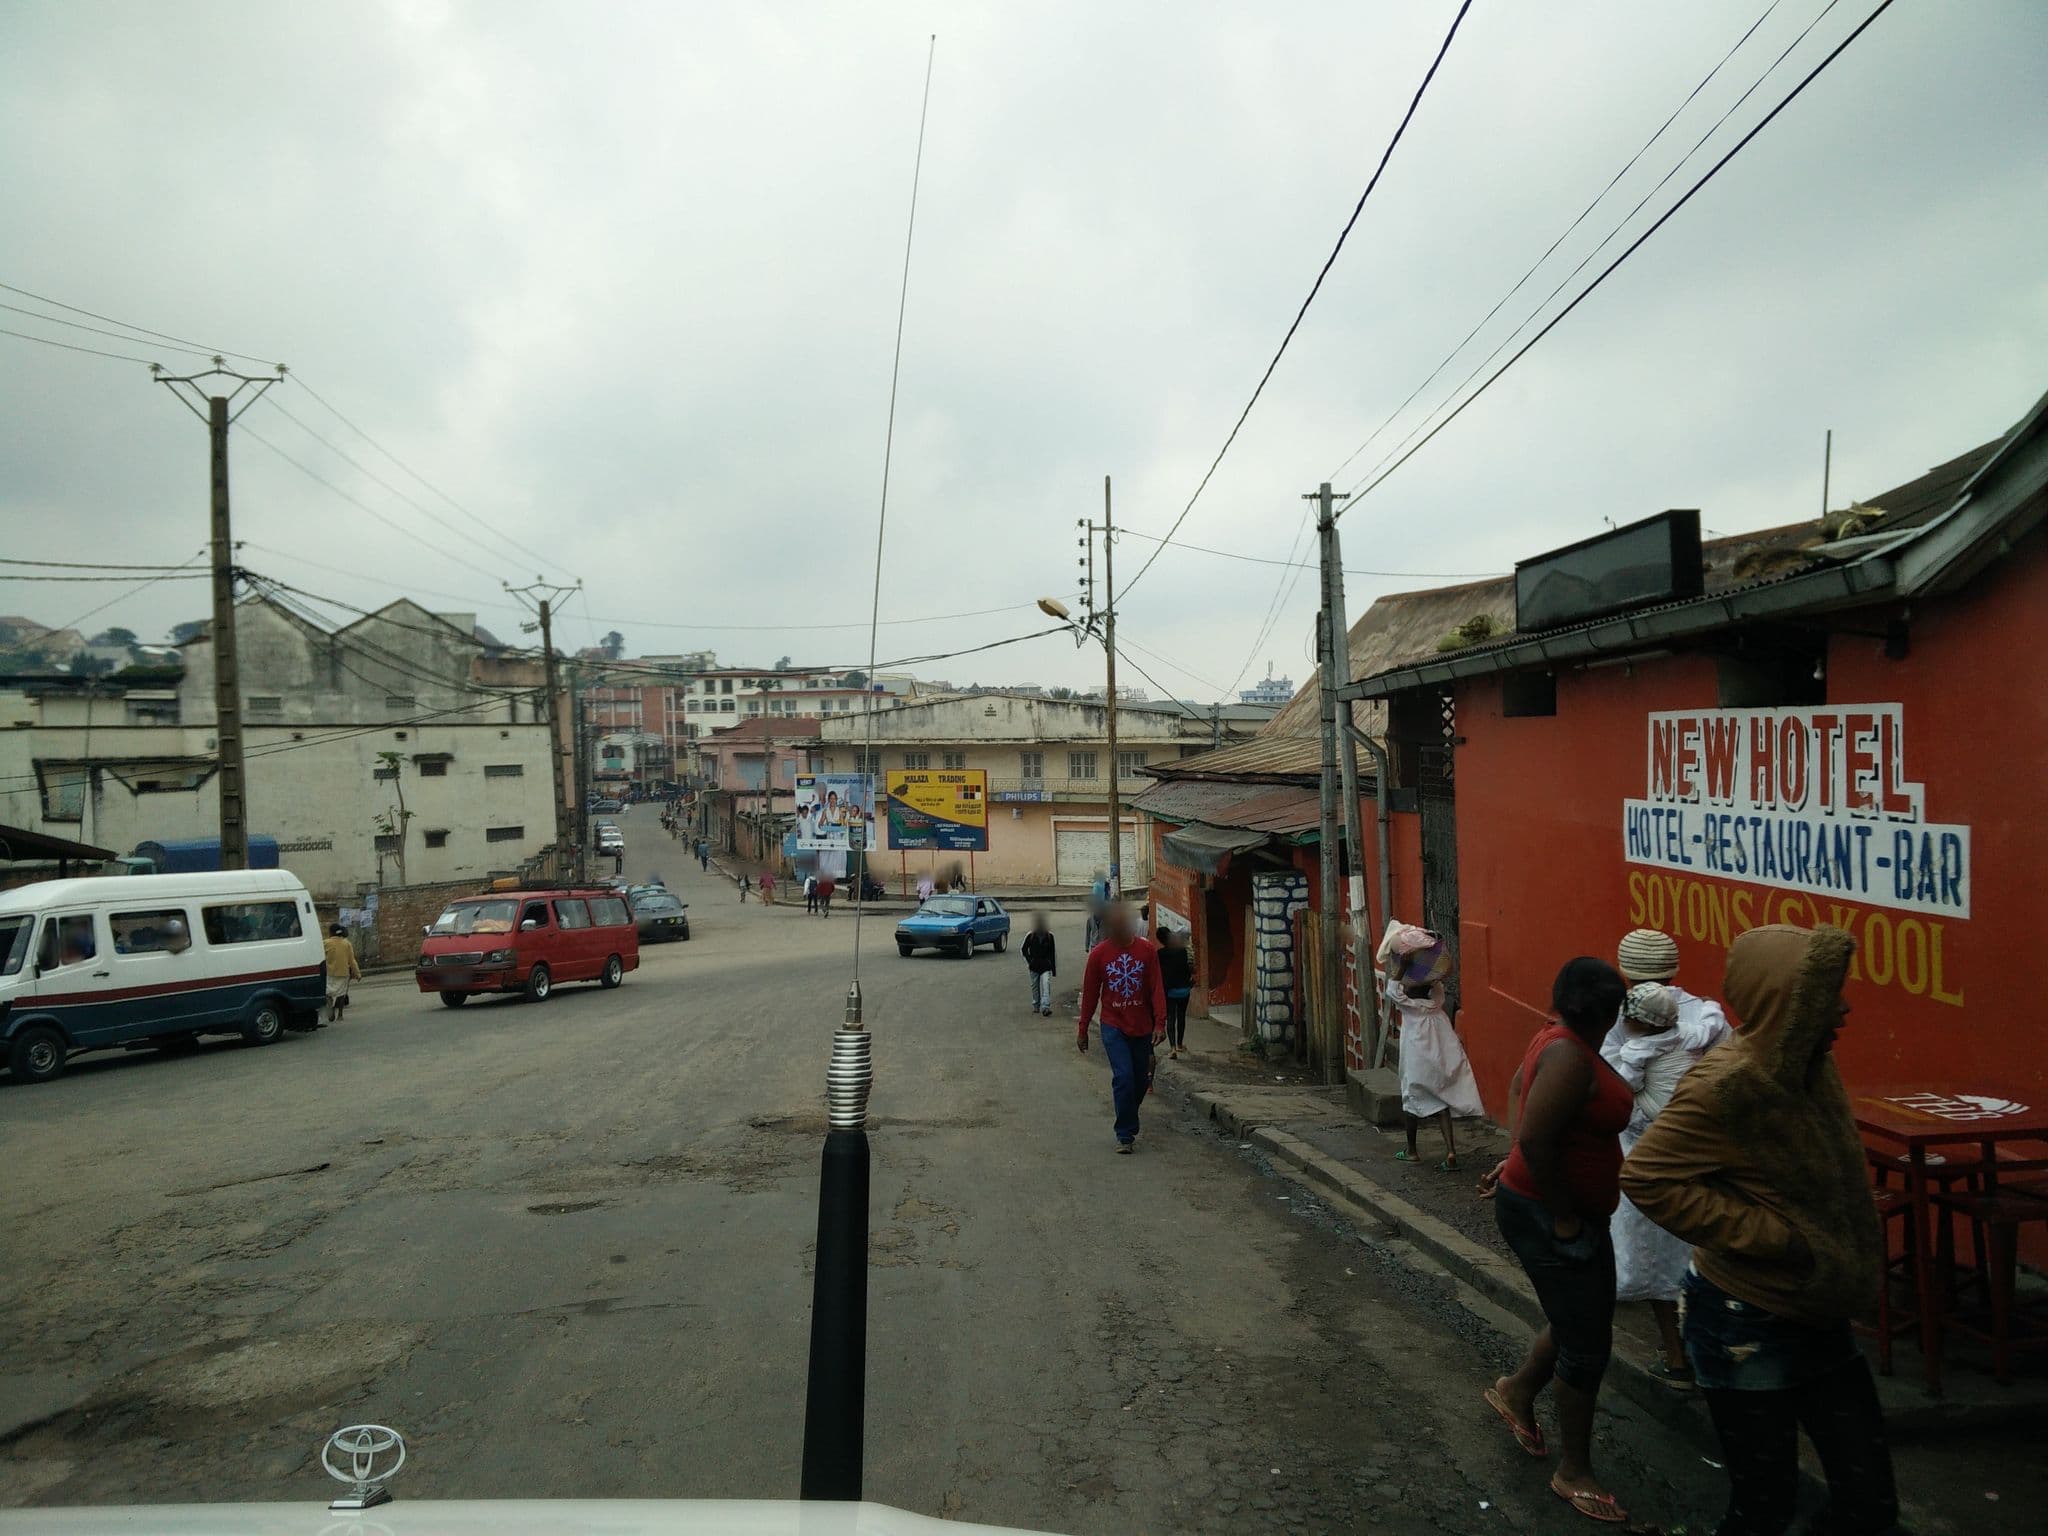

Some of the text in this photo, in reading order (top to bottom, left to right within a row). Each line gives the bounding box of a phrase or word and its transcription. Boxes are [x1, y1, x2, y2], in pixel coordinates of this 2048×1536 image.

[938, 775, 966, 784] TRADING
[1651, 713, 1917, 824] NEW HOTEL
[1005, 793, 1037, 801] PHILIPS
[1628, 870, 1754, 948] SOYONS
